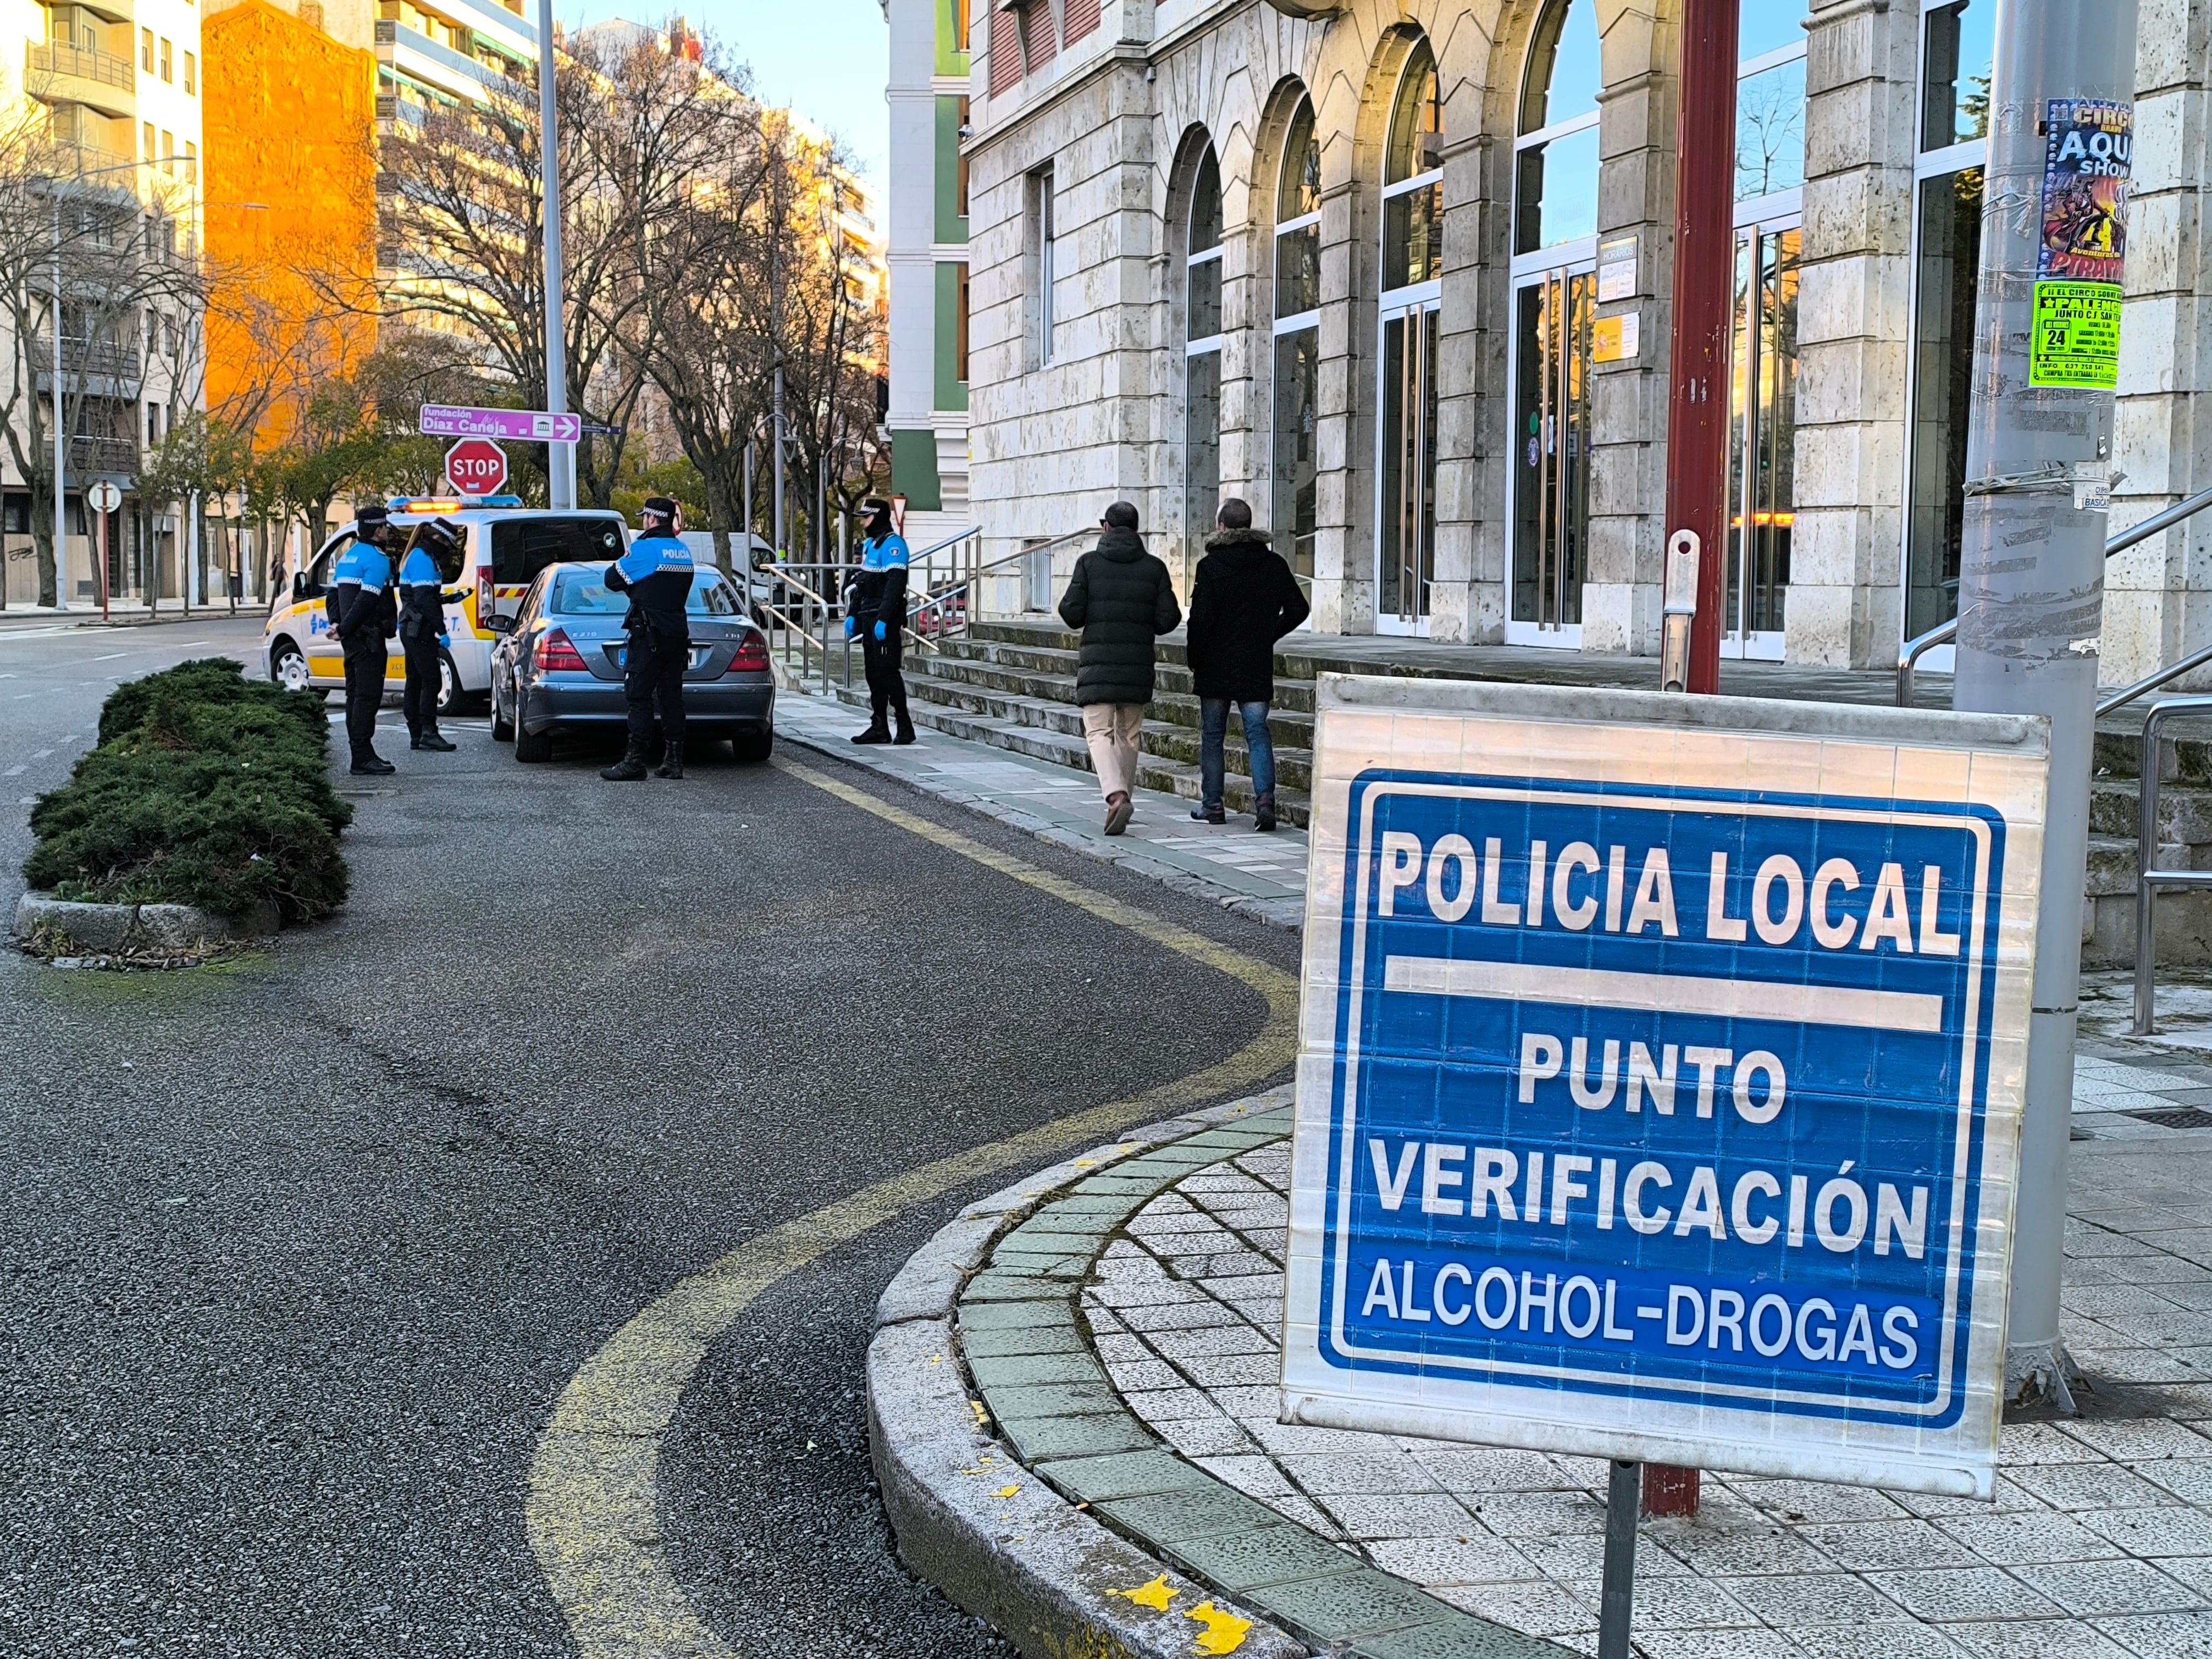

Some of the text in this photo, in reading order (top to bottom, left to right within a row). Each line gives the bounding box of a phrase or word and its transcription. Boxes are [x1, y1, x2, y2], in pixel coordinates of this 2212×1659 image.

[2074, 107, 2133, 130] CIRCO
[2080, 160, 2129, 178] SHOW
[1603, 246, 1634, 261] HORARIOS
[2069, 288, 2095, 297] CIRCO
[2055, 310, 2084, 318] JUNTO
[2101, 312, 2112, 320] SAN
[2047, 330, 2065, 345] 24
[424, 407, 472, 419] fundación
[423, 417, 453, 431] Díaz
[453, 459, 499, 476] STOP
[1377, 830, 1962, 957] POLICIA LOCAL
[1516, 1031, 1786, 1125] PUNTO
[1368, 1138, 1929, 1261] VERIFICACIÓN
[1360, 1257, 1919, 1370] ALCOHOL-DROGAS
